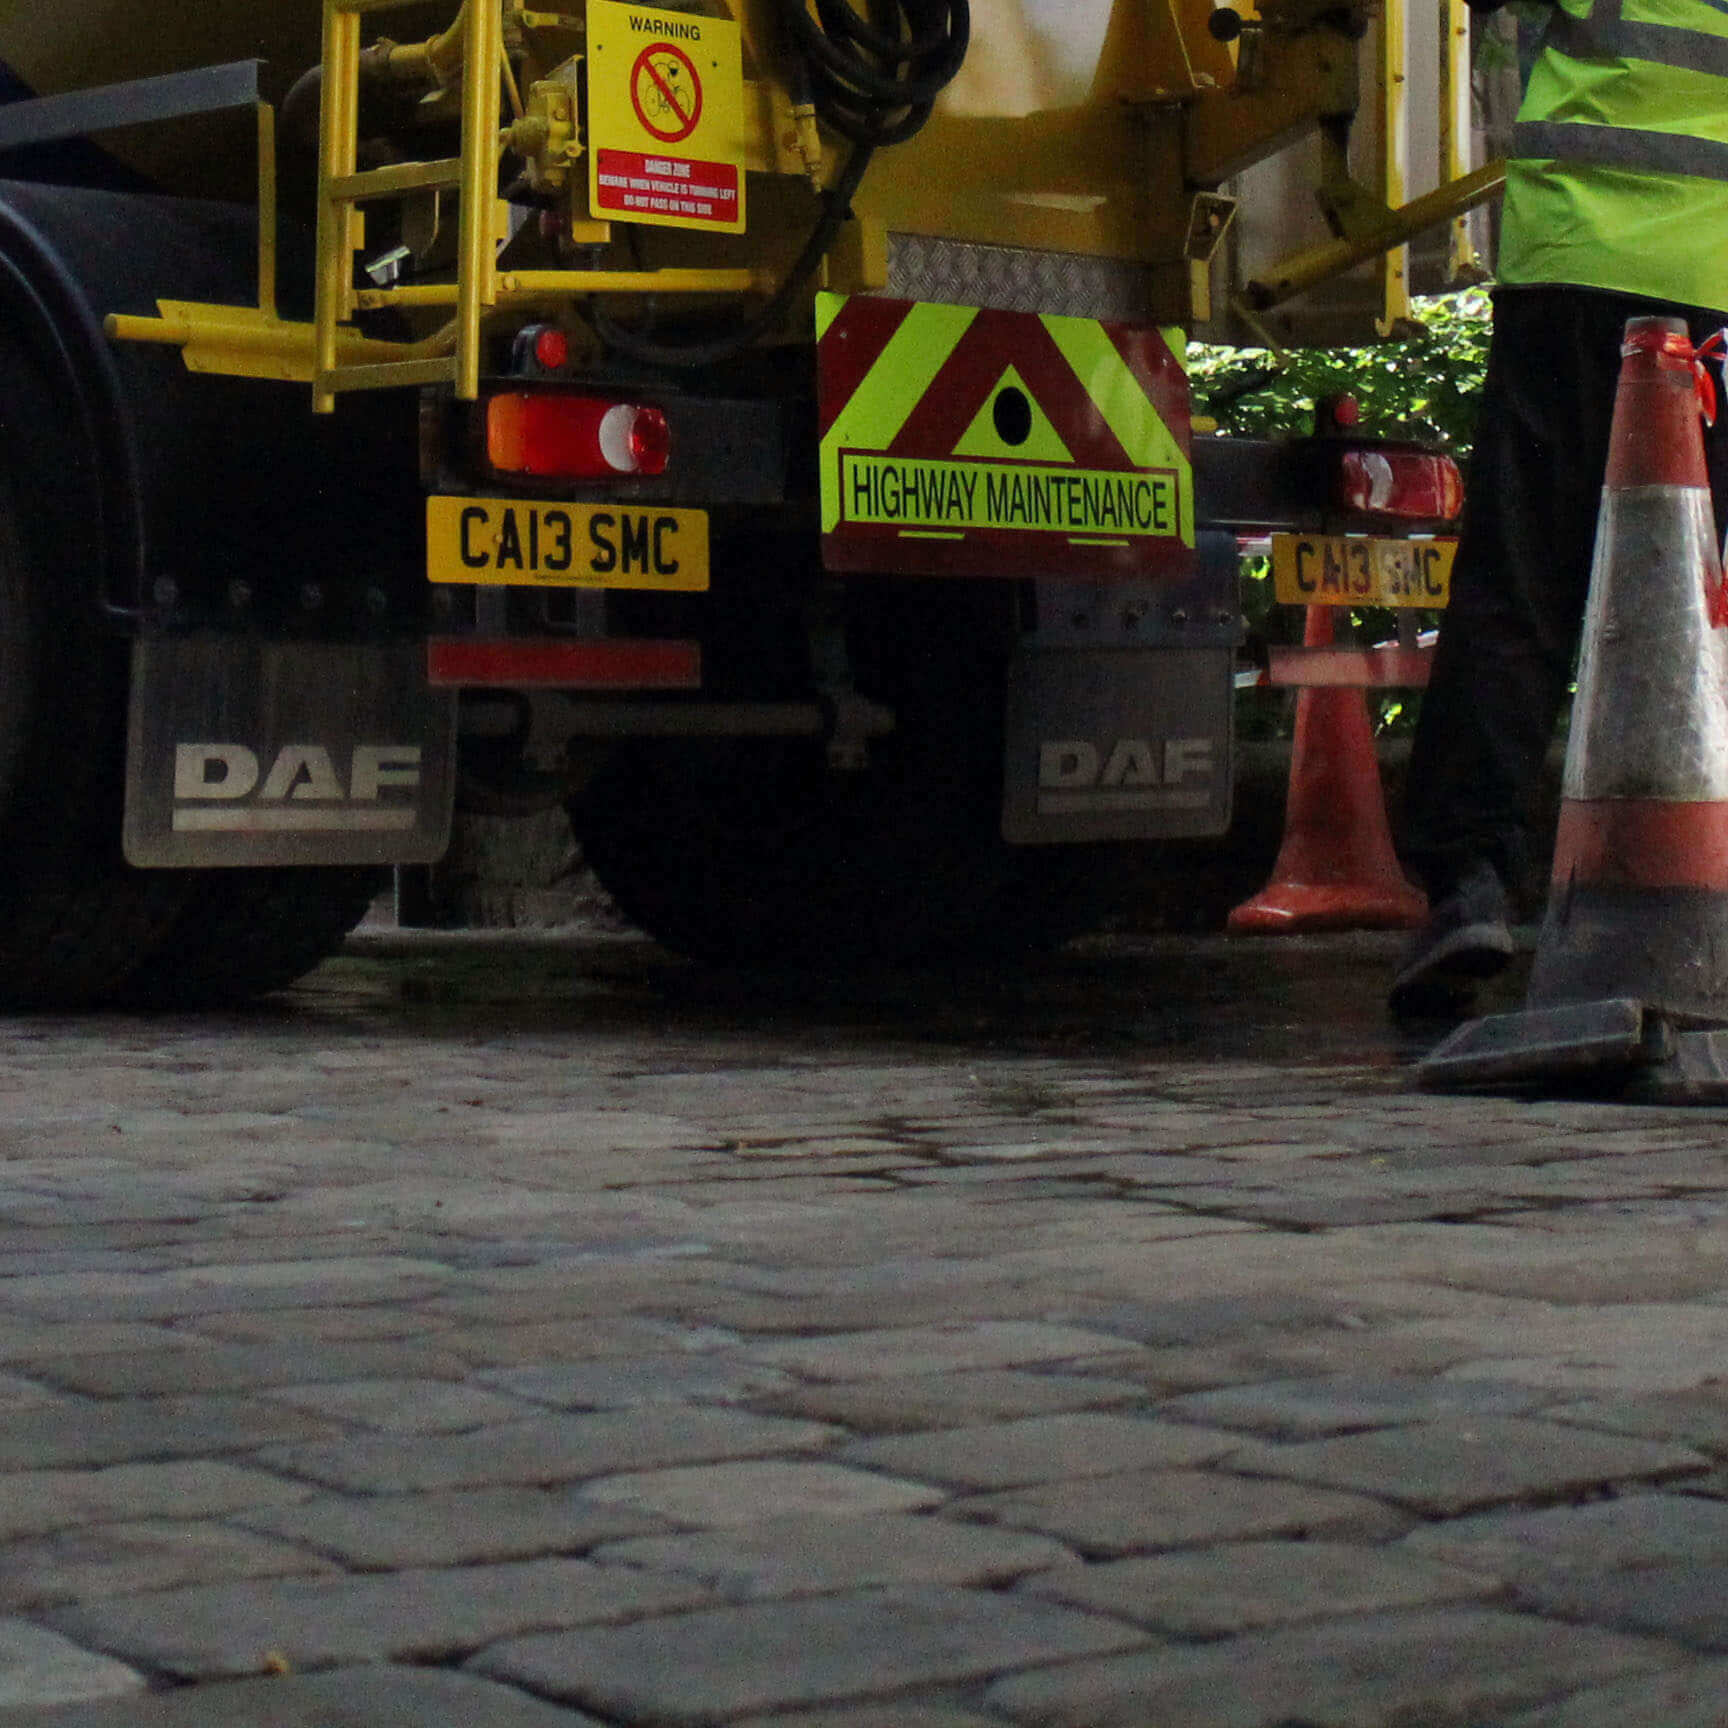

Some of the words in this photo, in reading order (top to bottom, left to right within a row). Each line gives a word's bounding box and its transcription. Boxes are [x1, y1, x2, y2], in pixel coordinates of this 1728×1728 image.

[629, 15, 701, 41] WARNING
[651, 180, 679, 195] VEHICLE
[719, 188, 736, 201] LEFT
[852, 463, 978, 521] HIGHWAY
[986, 471, 1168, 530] MAINTENANCE
[461, 506, 572, 571] CA13
[590, 513, 680, 575] SMC
[1296, 541, 1370, 595] CA13
[173, 743, 421, 800] DAF
[1039, 740, 1213, 786] DAF
